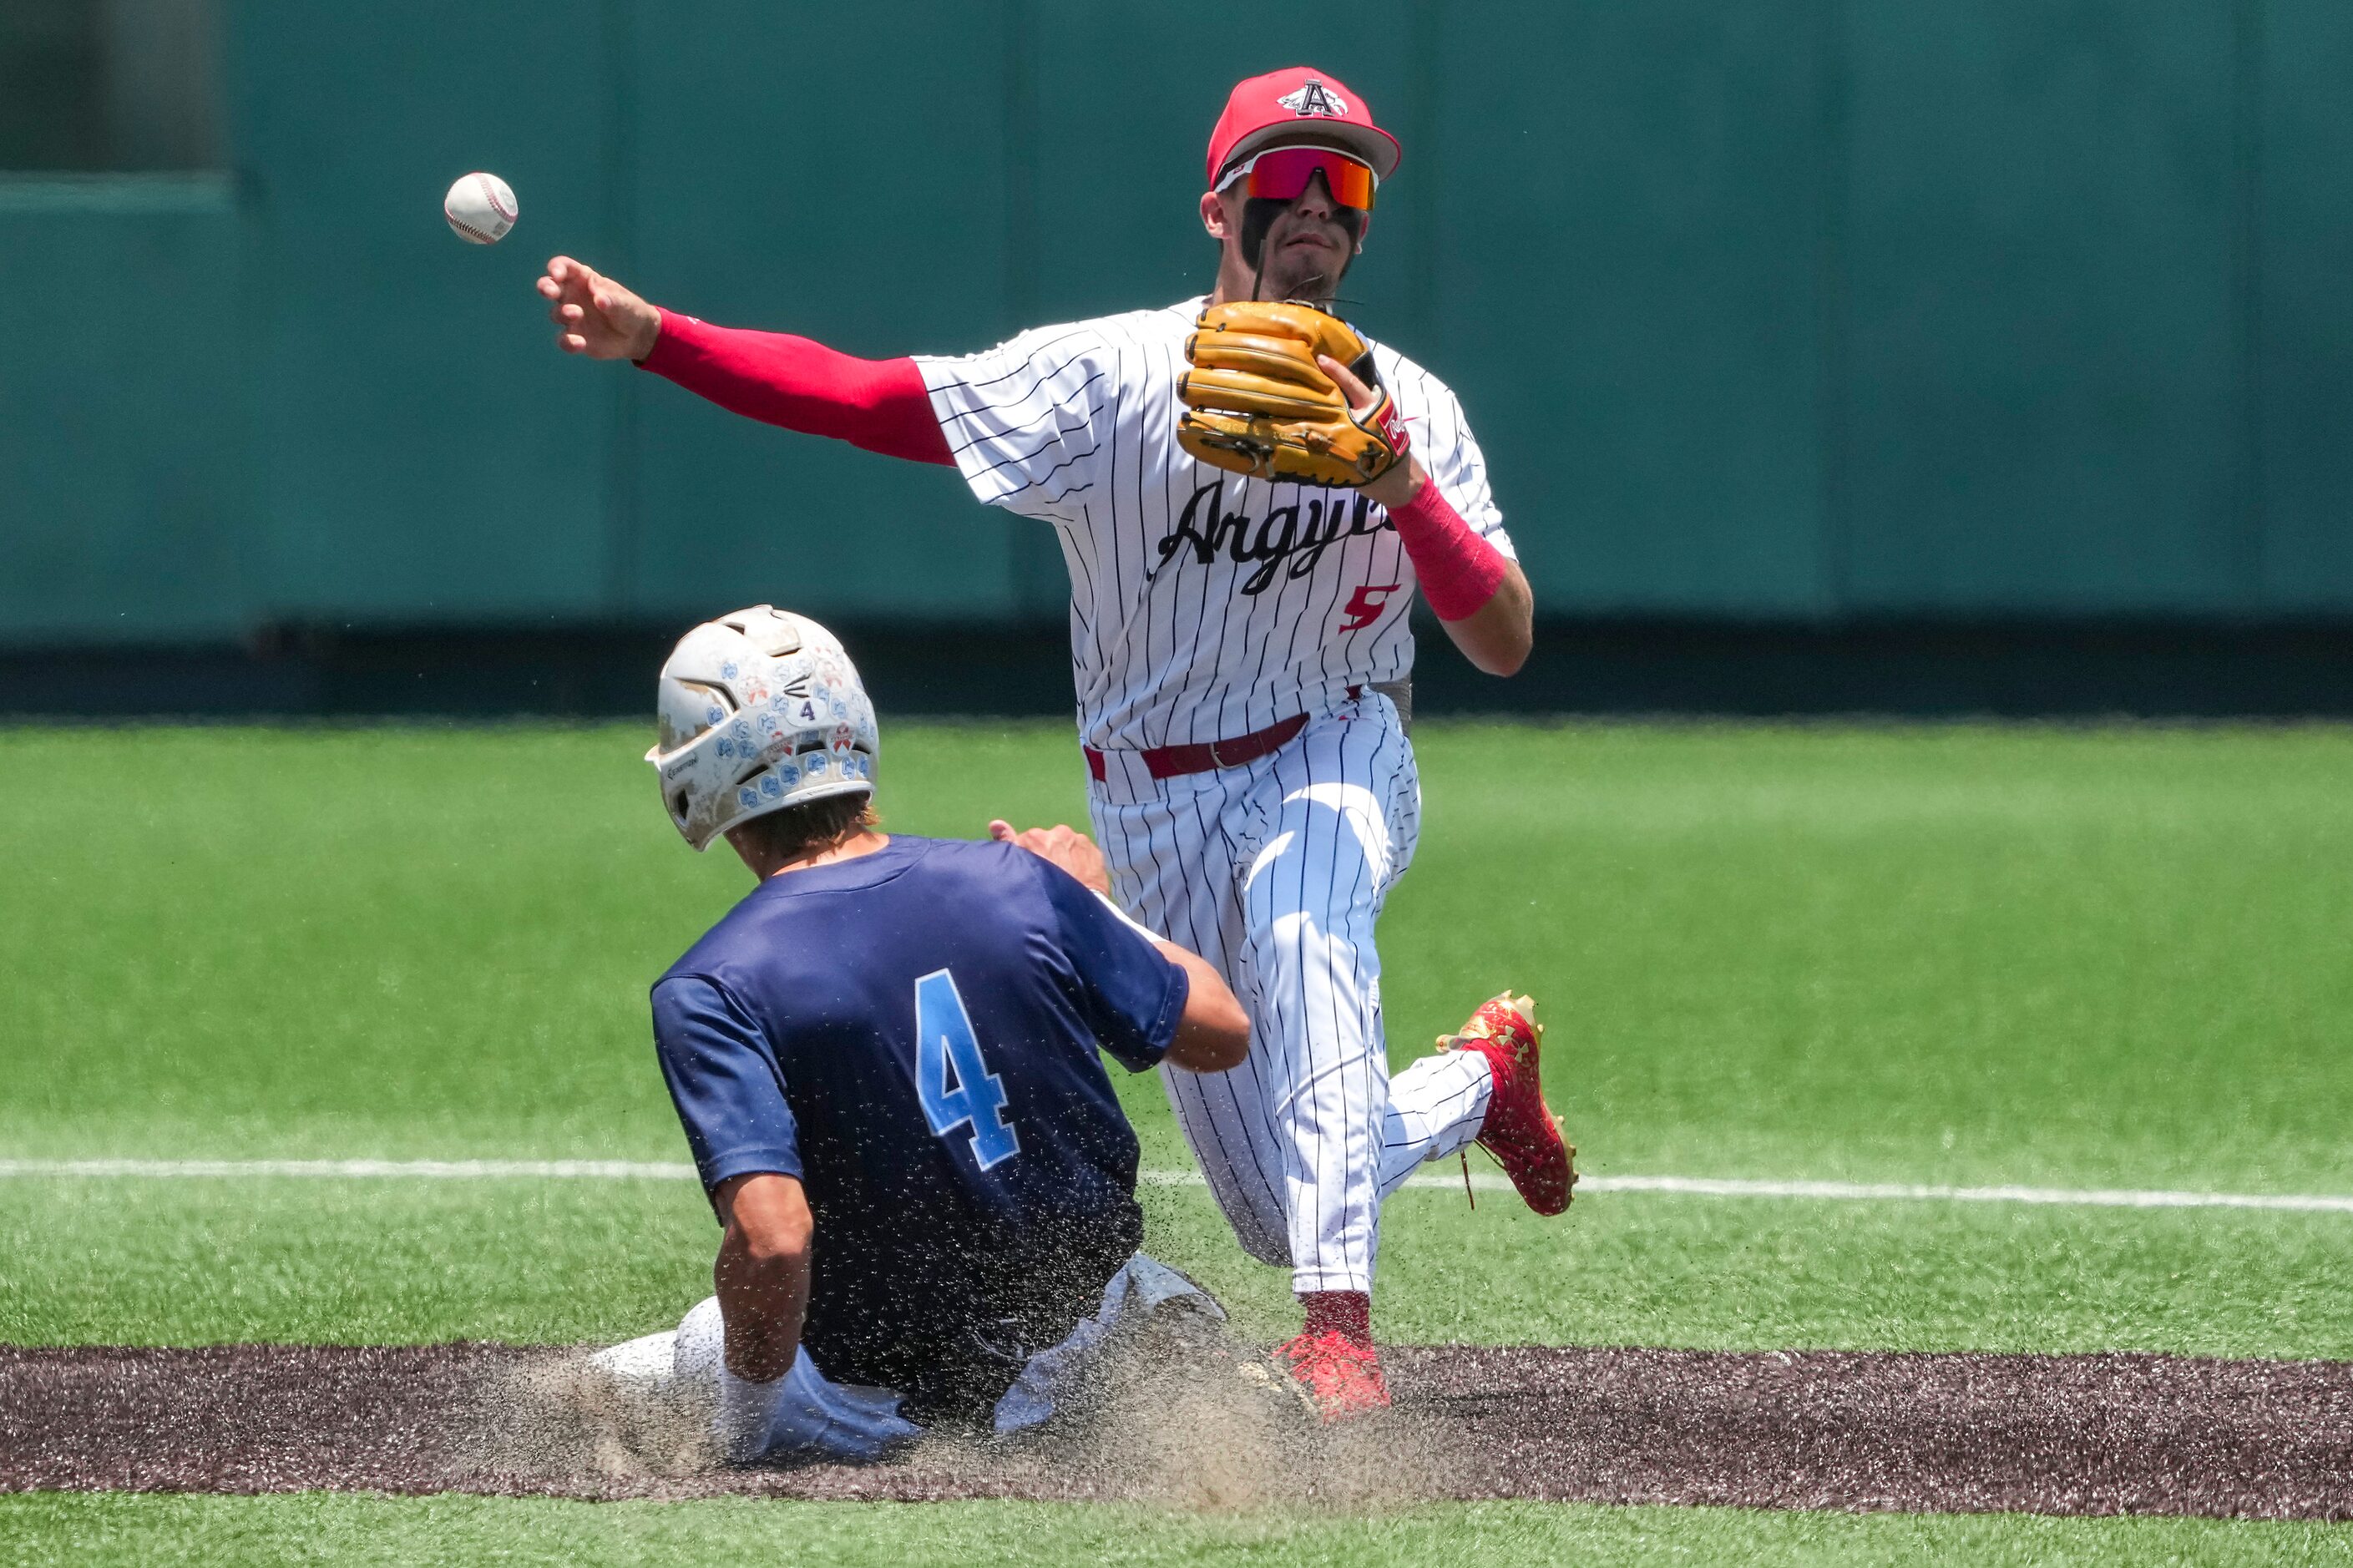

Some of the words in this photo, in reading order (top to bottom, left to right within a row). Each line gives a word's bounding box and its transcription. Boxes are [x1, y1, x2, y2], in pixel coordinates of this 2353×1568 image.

[1296, 79, 1334, 117] A
[1338, 584, 1401, 635] 5
[799, 701, 816, 721] 4
[914, 967, 1021, 1172] 4
